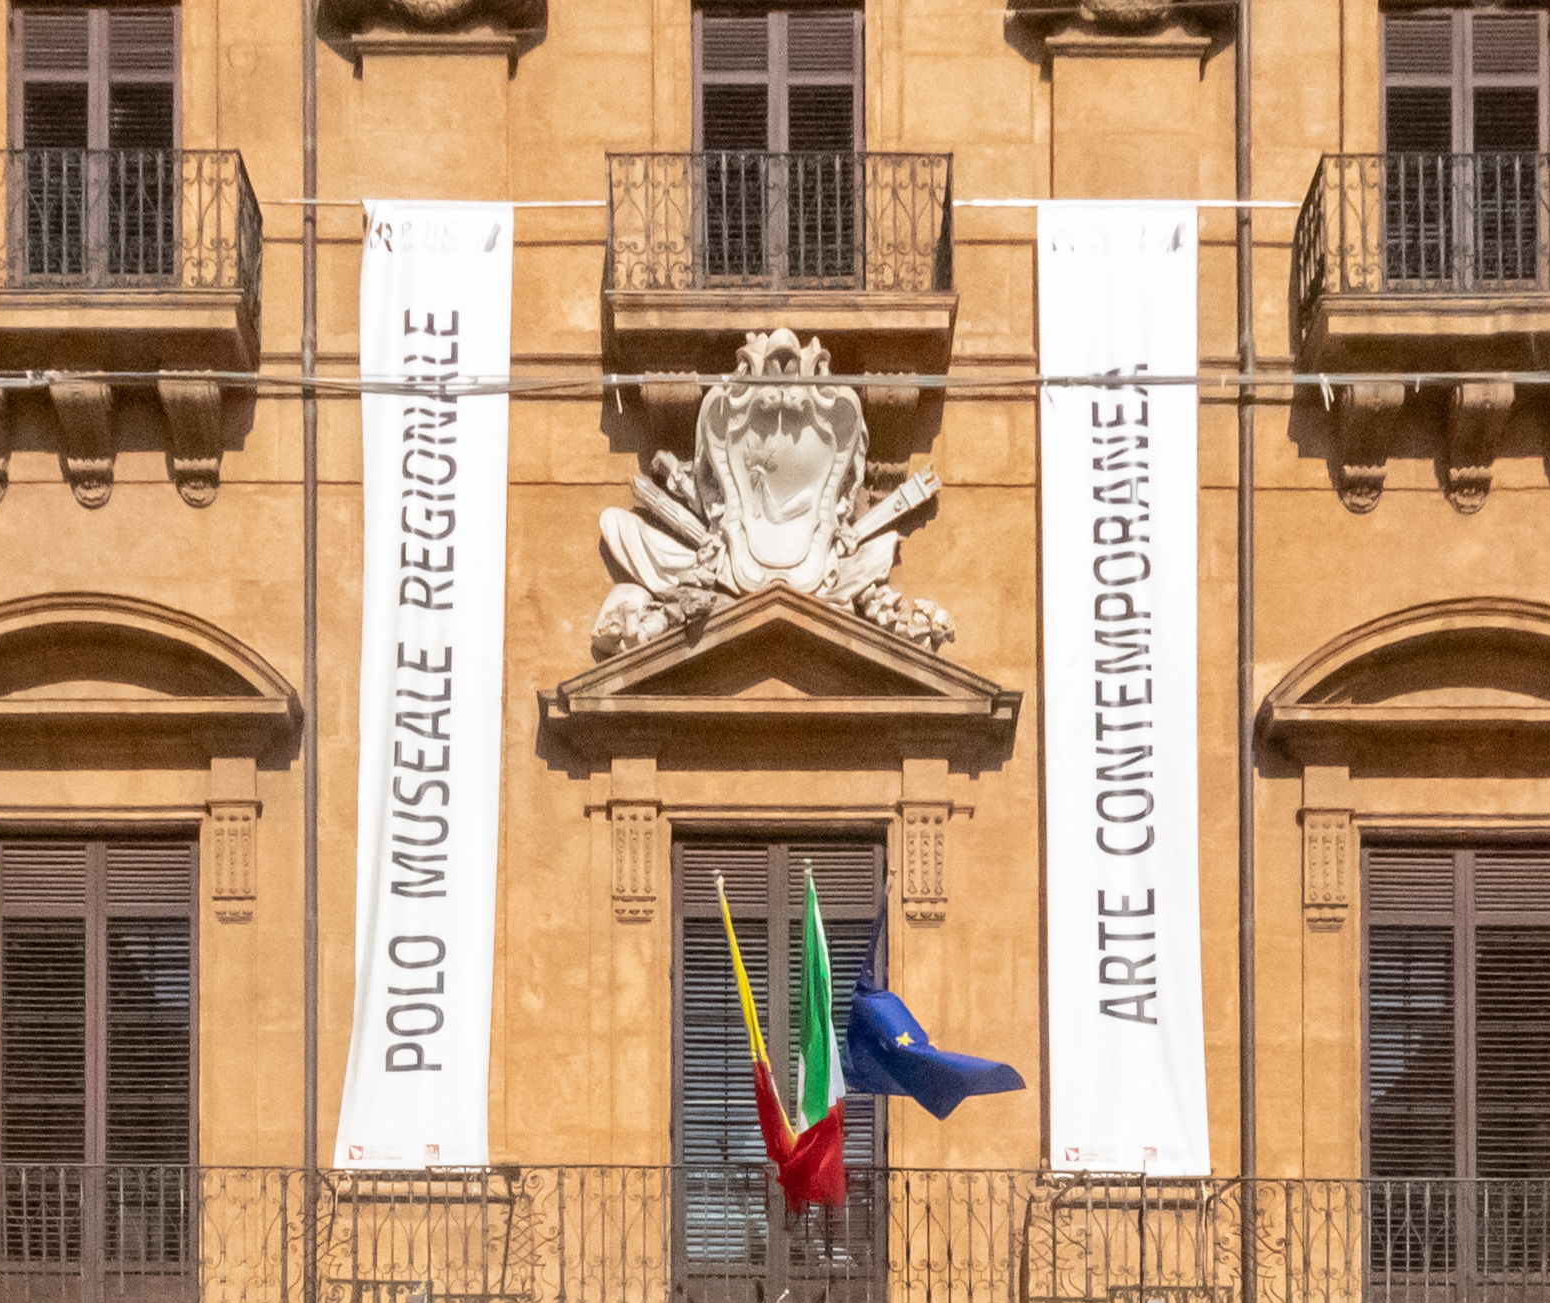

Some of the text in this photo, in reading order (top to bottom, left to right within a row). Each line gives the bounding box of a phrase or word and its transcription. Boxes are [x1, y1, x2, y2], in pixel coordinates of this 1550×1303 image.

[398, 308, 459, 611] REGIONALE
[390, 640, 454, 898] MUSEALE
[1092, 363, 1157, 1027] ARTE CONTEMPORANEA
[385, 934, 447, 1073] POLO
